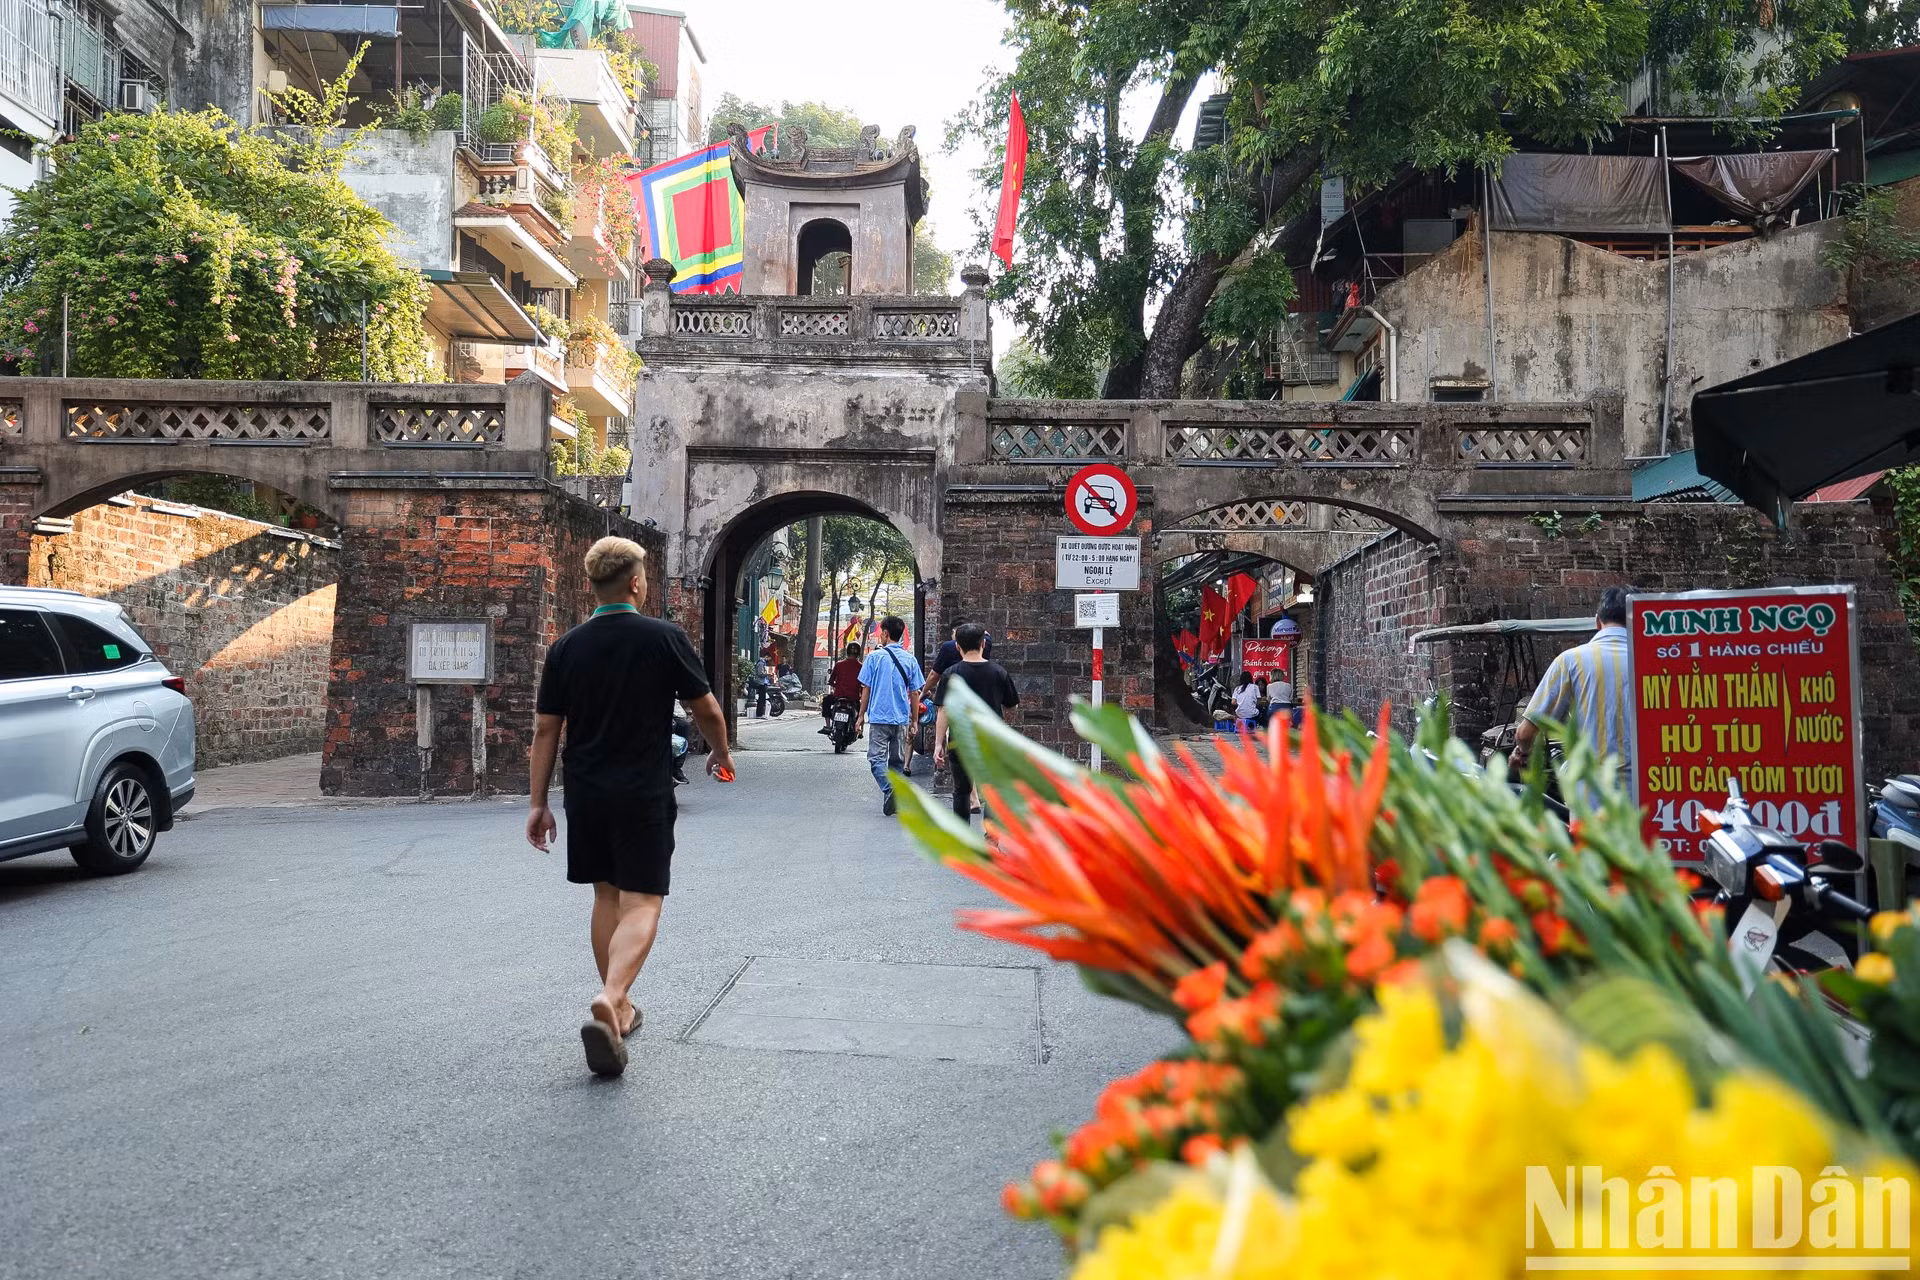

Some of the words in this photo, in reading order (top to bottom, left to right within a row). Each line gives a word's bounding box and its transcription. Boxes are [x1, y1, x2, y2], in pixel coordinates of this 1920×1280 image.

[1084, 566, 1104, 576] NGOẠI
[1105, 565, 1113, 576] LỆ
[1086, 576, 1111, 586] Except
[1642, 607, 1742, 636] MINH
[1748, 603, 1835, 636] NGỌ
[1657, 643, 1681, 658] SỐ
[1687, 642, 1703, 657] 1
[1709, 642, 1761, 657] HÀNG
[1767, 638, 1824, 655] CHIẾU
[1642, 668, 1671, 709] MỲ
[1677, 661, 1719, 709] VẰN
[1723, 661, 1778, 708] THẮN
[1800, 671, 1836, 703] KHÔ
[1661, 714, 1702, 752] HỦ
[1711, 718, 1762, 752] TÍU
[1795, 708, 1844, 743] NƯỚC
[1648, 756, 1682, 792] SỦI
[1689, 756, 1731, 792] CẢO
[1738, 761, 1786, 792] TÔM
[1792, 764, 1844, 794] TƯƠI
